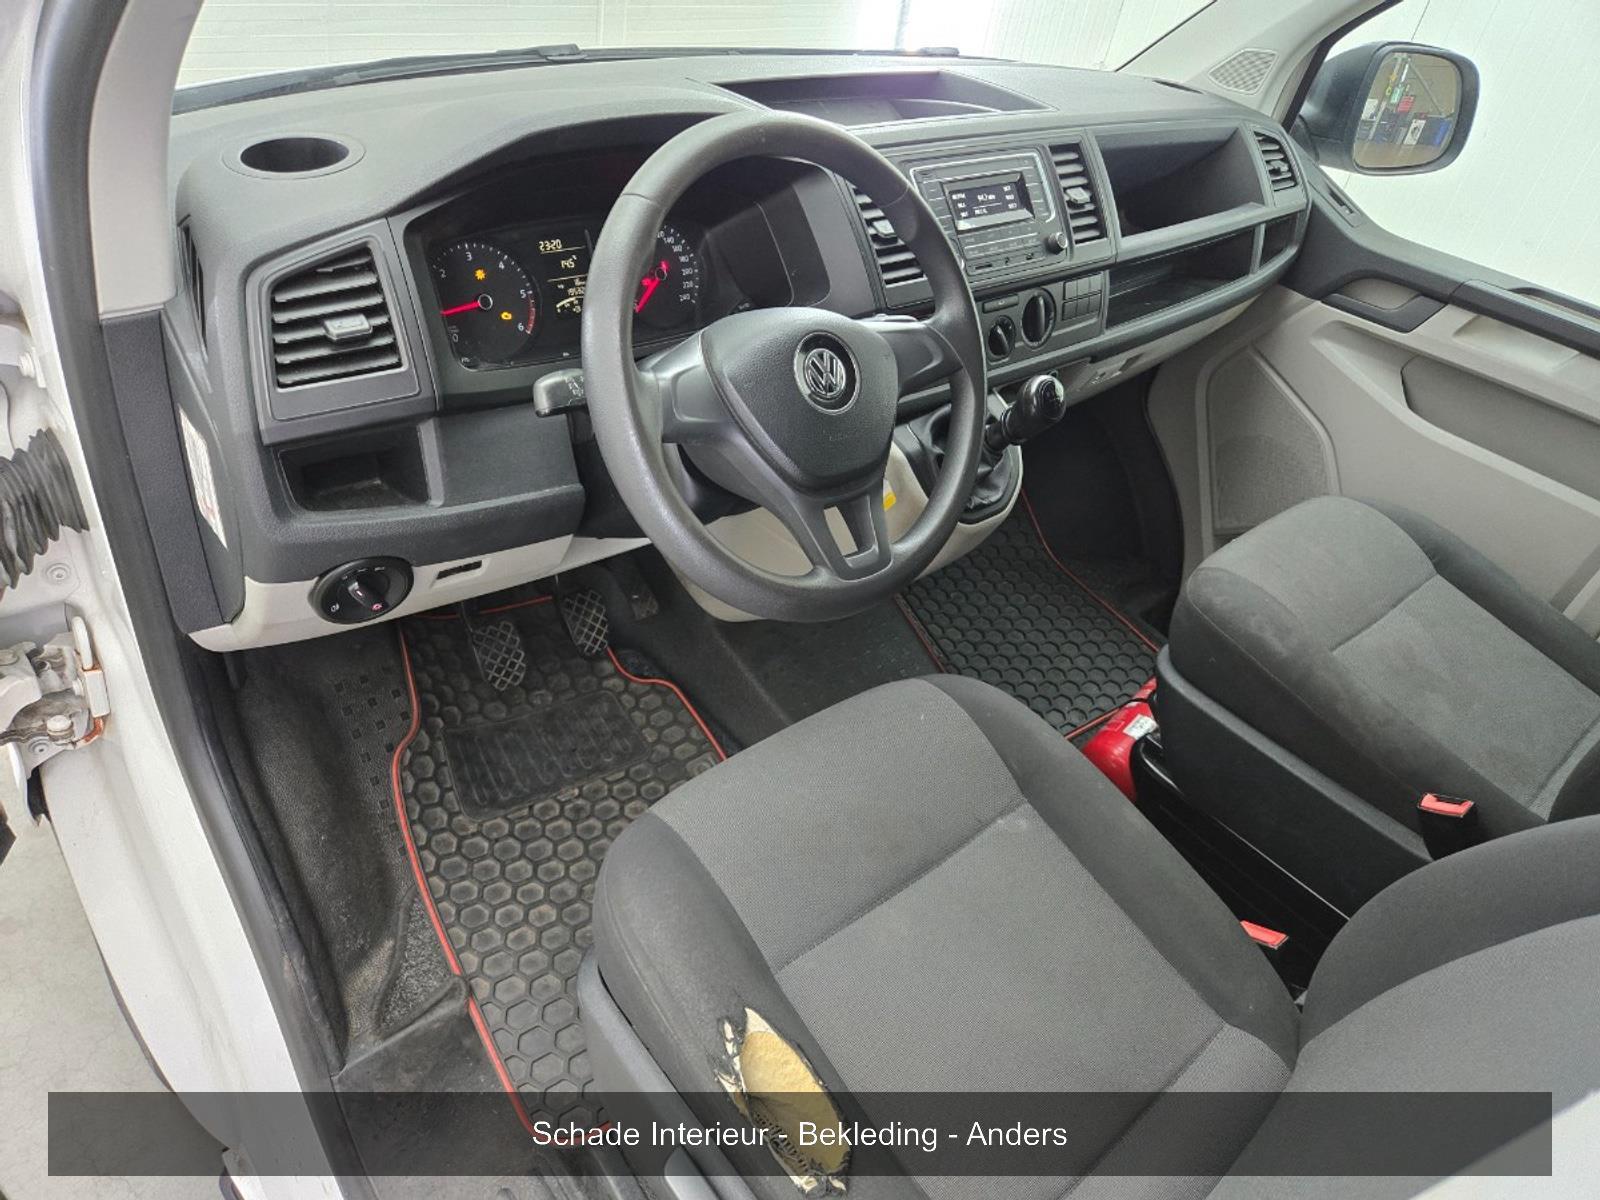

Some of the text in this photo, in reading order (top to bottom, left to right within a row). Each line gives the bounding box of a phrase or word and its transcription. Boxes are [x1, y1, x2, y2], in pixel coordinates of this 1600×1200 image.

[466, 251, 473, 261] 3
[498, 260, 505, 270] 4
[439, 269, 446, 279] 2
[519, 289, 527, 299] 5
[517, 322, 525, 332] 6
[452, 333, 459, 343] 0
